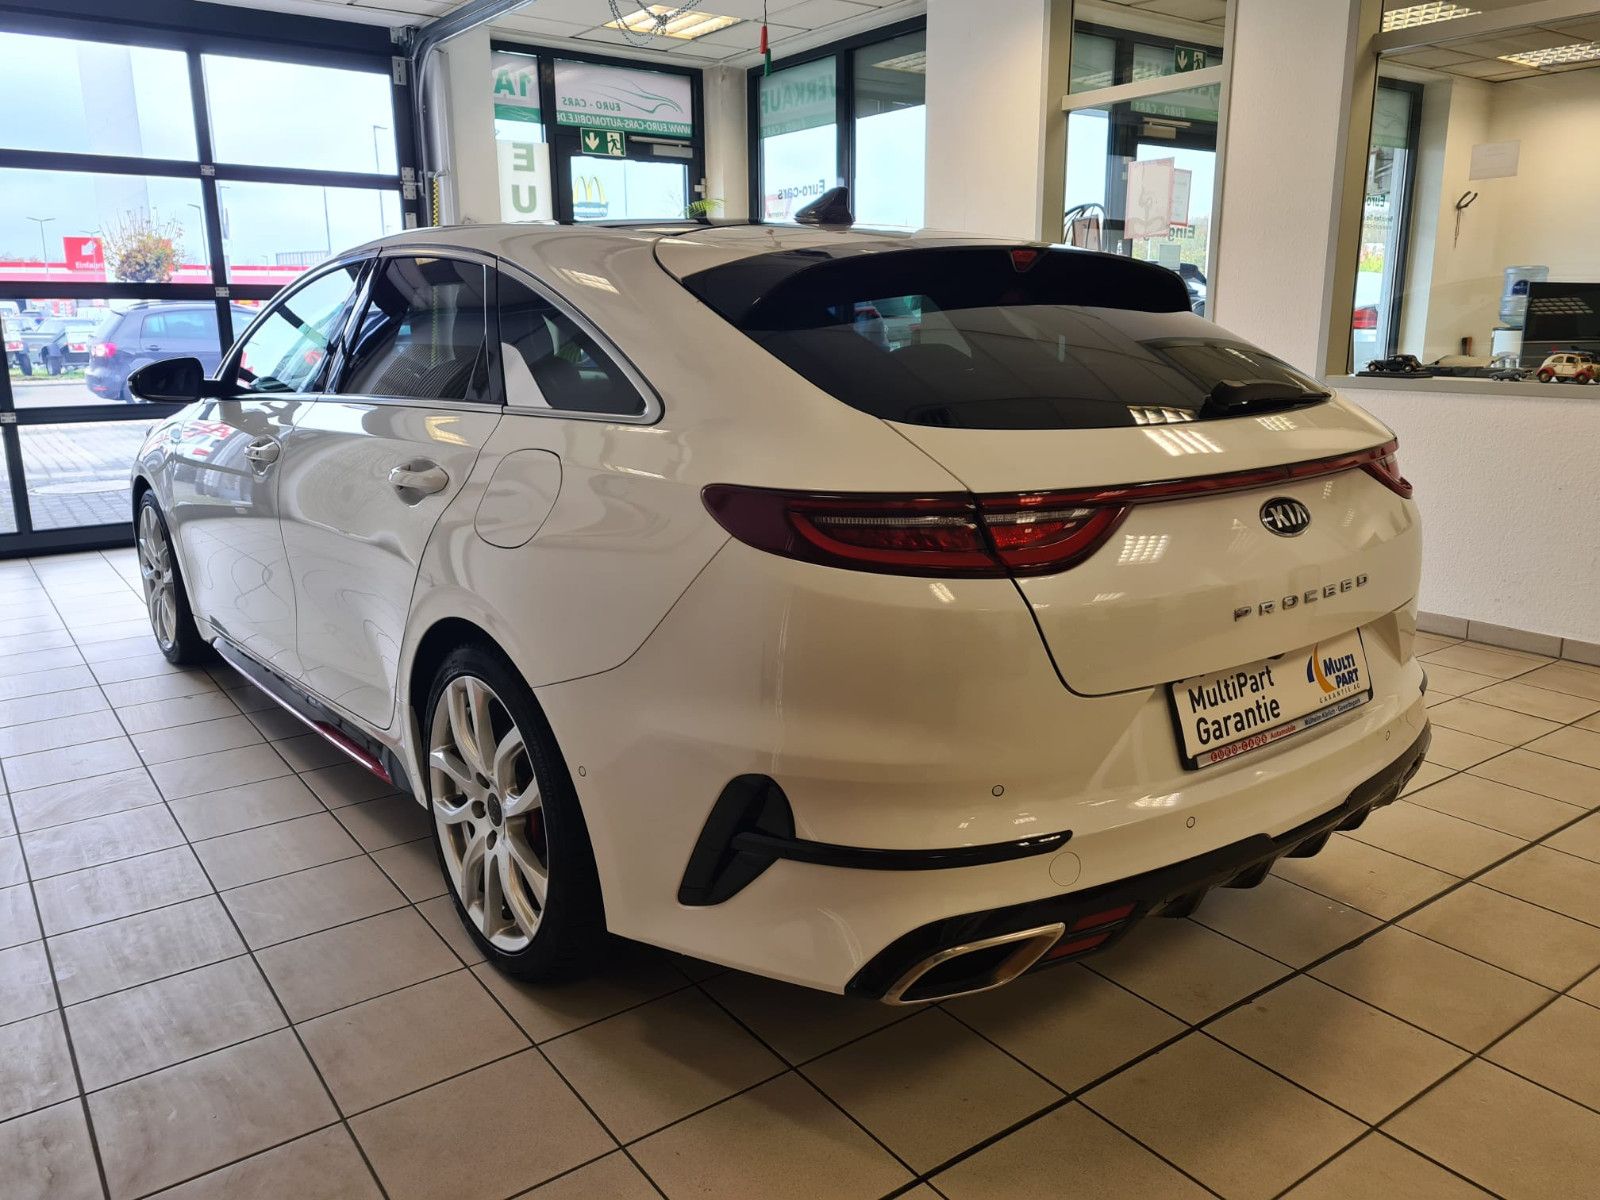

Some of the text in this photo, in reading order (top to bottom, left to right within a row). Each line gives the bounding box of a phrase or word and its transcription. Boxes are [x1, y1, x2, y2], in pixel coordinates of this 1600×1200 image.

[1268, 502, 1308, 528] KIA
[1233, 573, 1369, 622] PROCEED
[1323, 653, 1356, 677] MULTI
[1335, 667, 1359, 688] PART
[1187, 665, 1275, 713] MultiPart
[1196, 695, 1280, 745] Garantie
